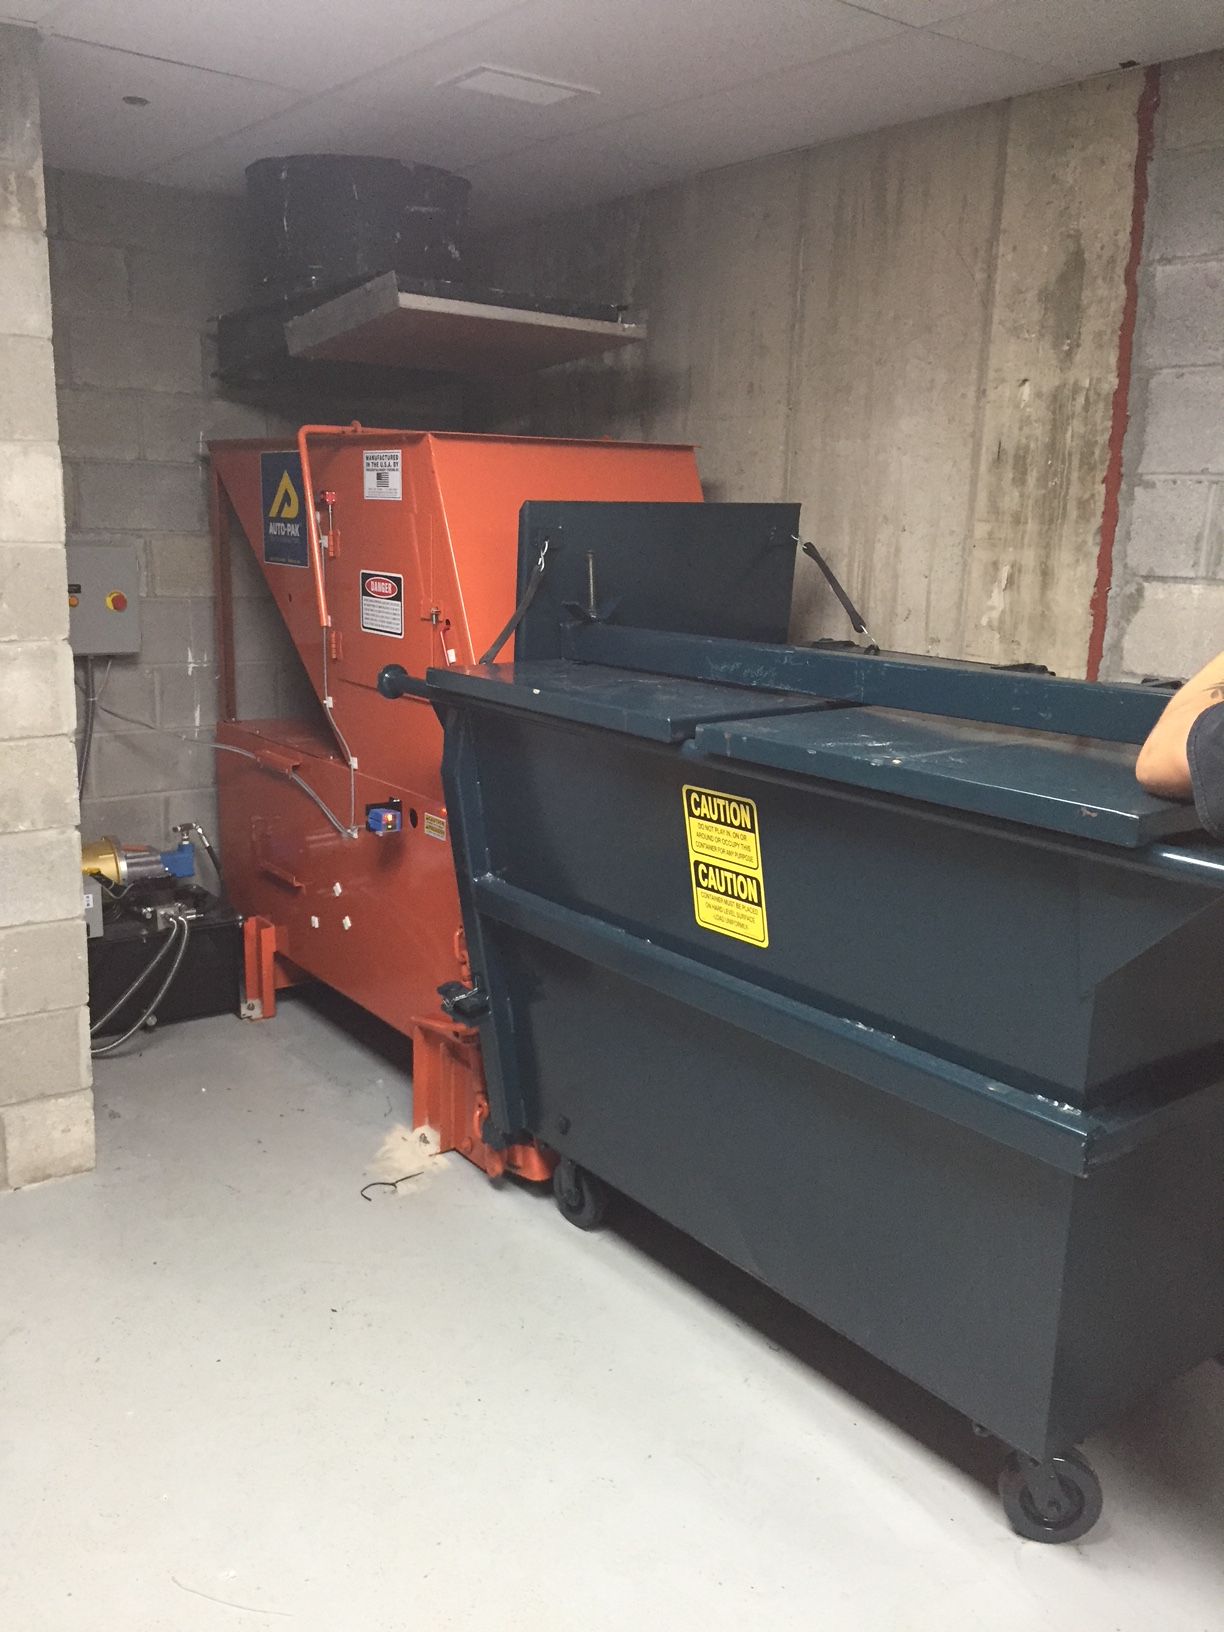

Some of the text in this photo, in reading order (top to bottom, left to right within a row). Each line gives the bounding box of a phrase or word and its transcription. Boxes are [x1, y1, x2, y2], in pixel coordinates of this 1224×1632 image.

[269, 522, 300, 537] AUTO-PAK
[370, 580, 392, 594] DANGER
[690, 792, 752, 830] CAUTION
[705, 825, 714, 833] NOT
[714, 827, 725, 835] PLAY
[695, 841, 717, 853] CONTAINER
[735, 851, 754, 864] PURPOSE
[696, 832, 714, 842] AROUND
[722, 838, 740, 848] OCCUPY
[741, 843, 751, 852] THIS
[698, 863, 759, 904] CAUTION
[700, 891, 759, 915] CONTAINER MUST BE PLACED
